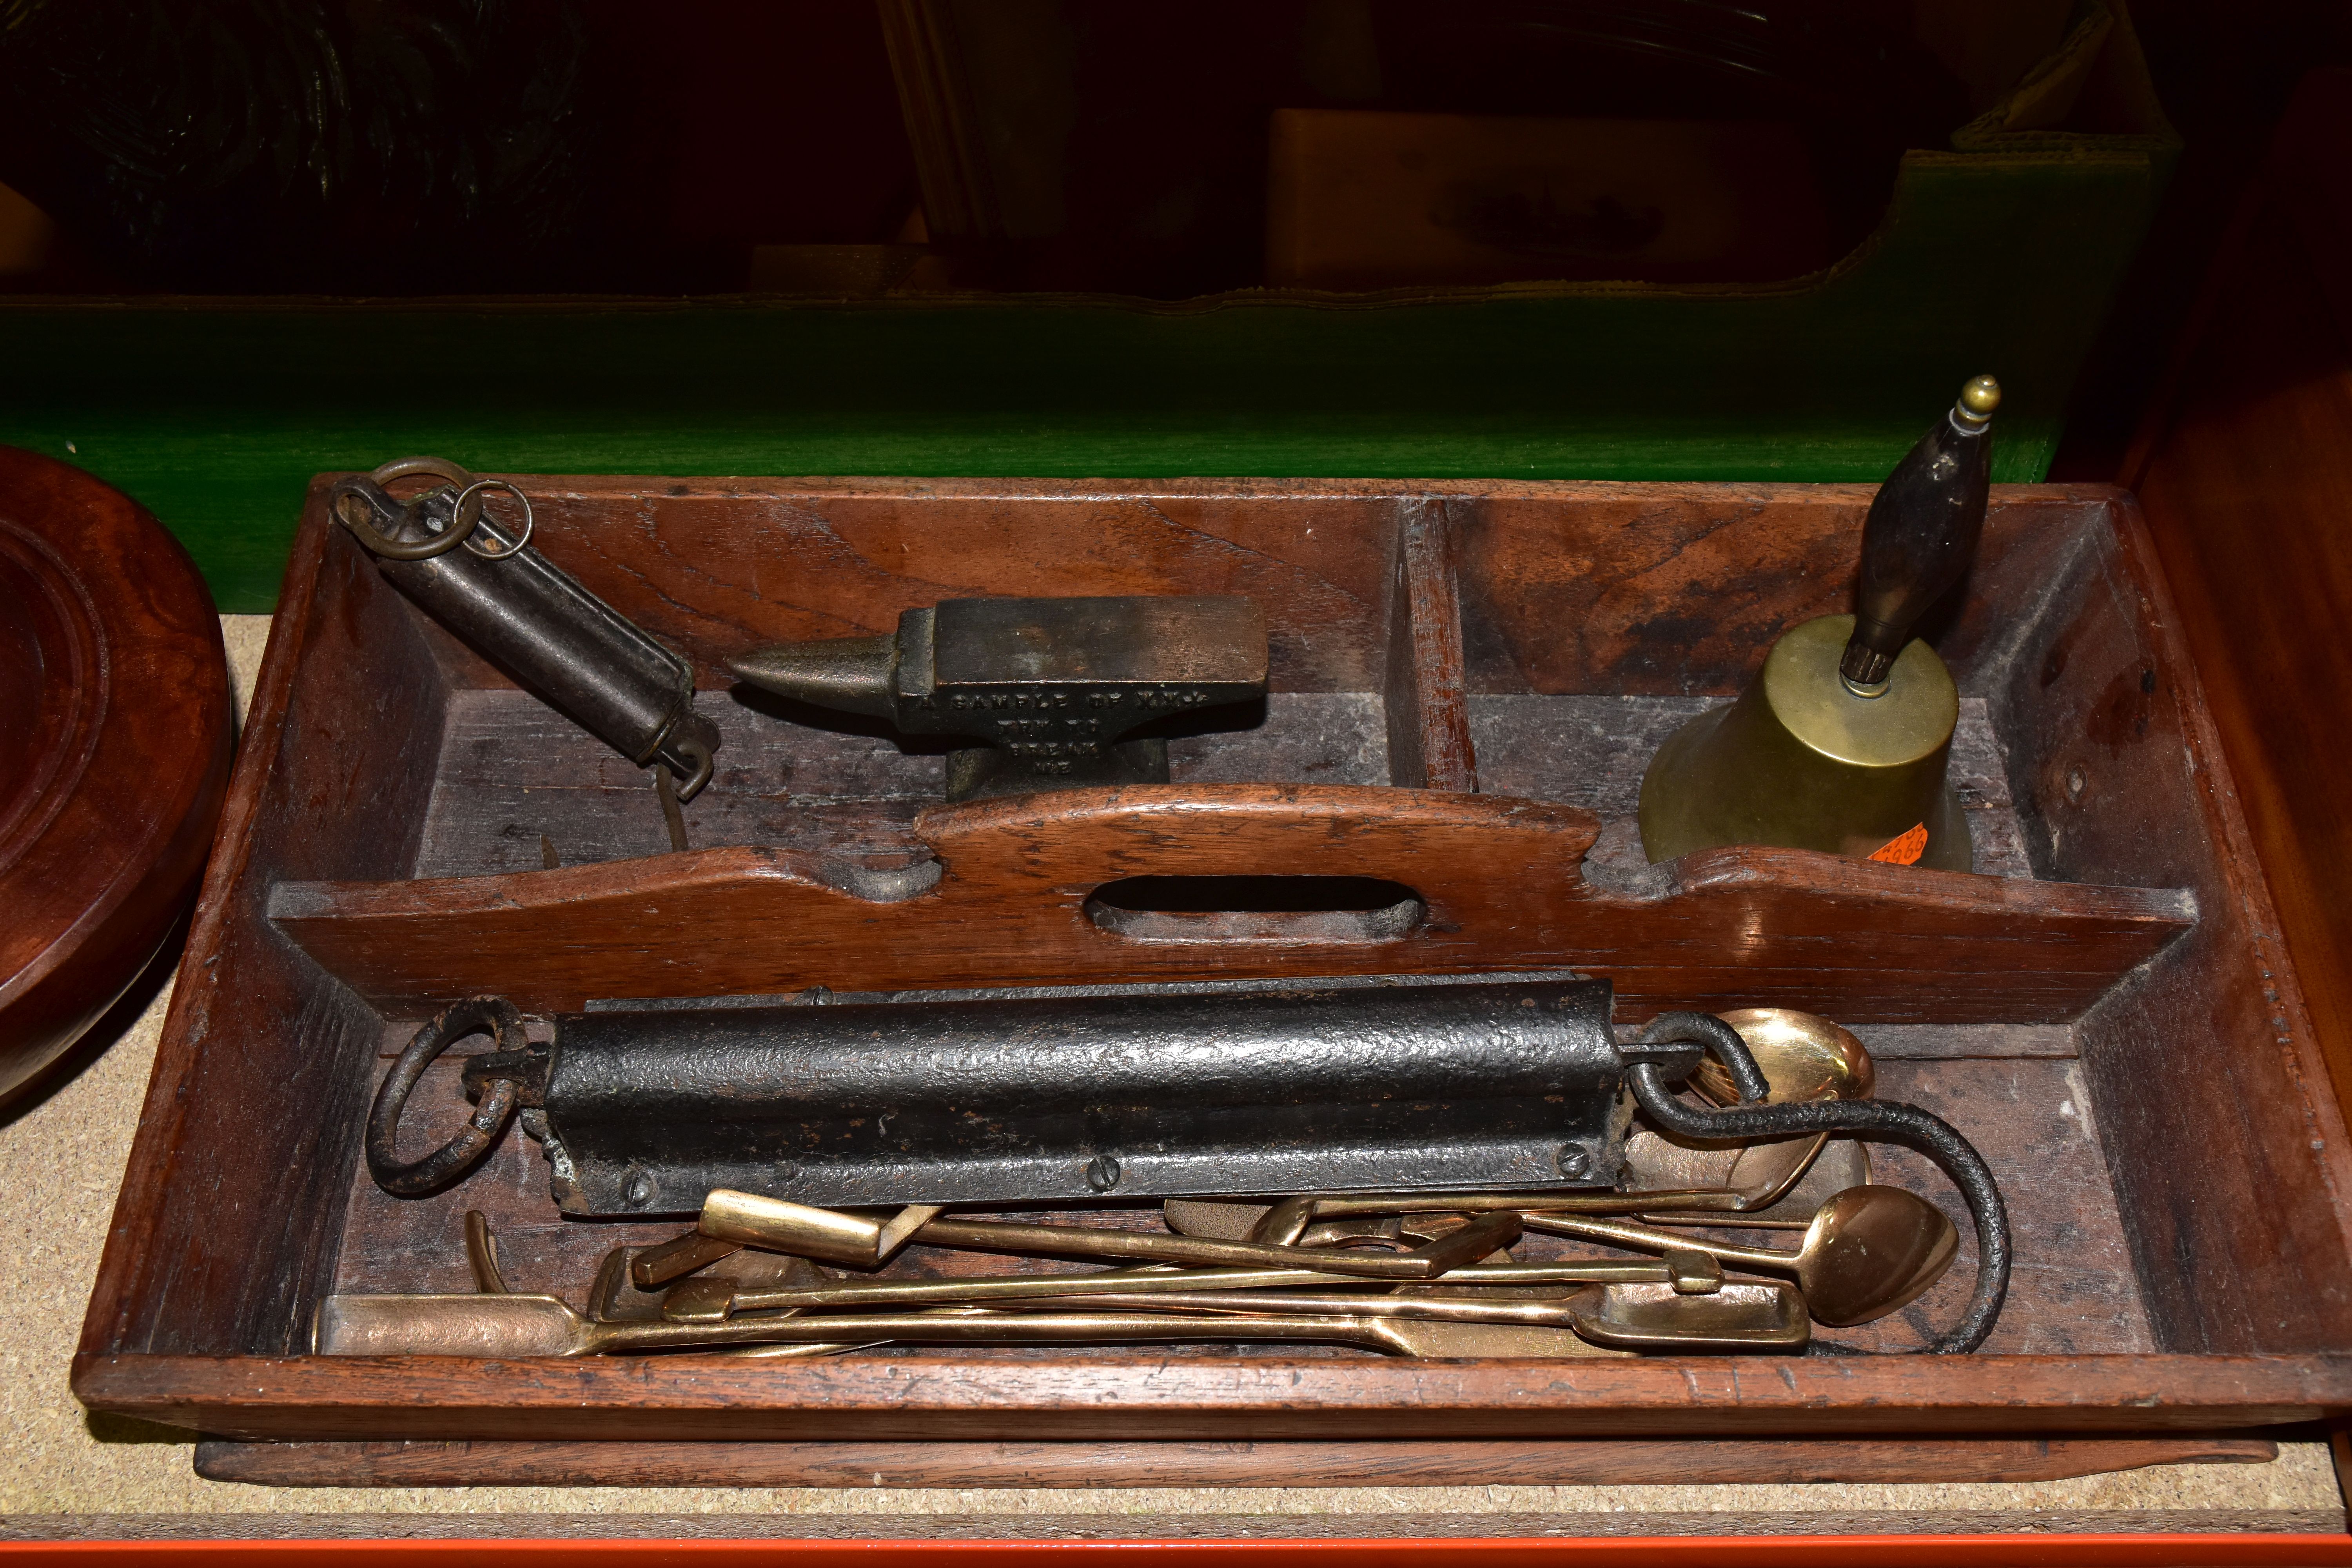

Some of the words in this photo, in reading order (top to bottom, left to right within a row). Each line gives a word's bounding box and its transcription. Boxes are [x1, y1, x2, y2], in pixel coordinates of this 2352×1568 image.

[920, 693, 935, 711] A
[950, 692, 1069, 711] SAMPLE
[1088, 692, 1123, 709] OF
[997, 719, 1050, 735] TRY
[1065, 718, 1099, 734] TO
[1009, 740, 1098, 758] BREAK
[1035, 760, 1073, 775] ME
